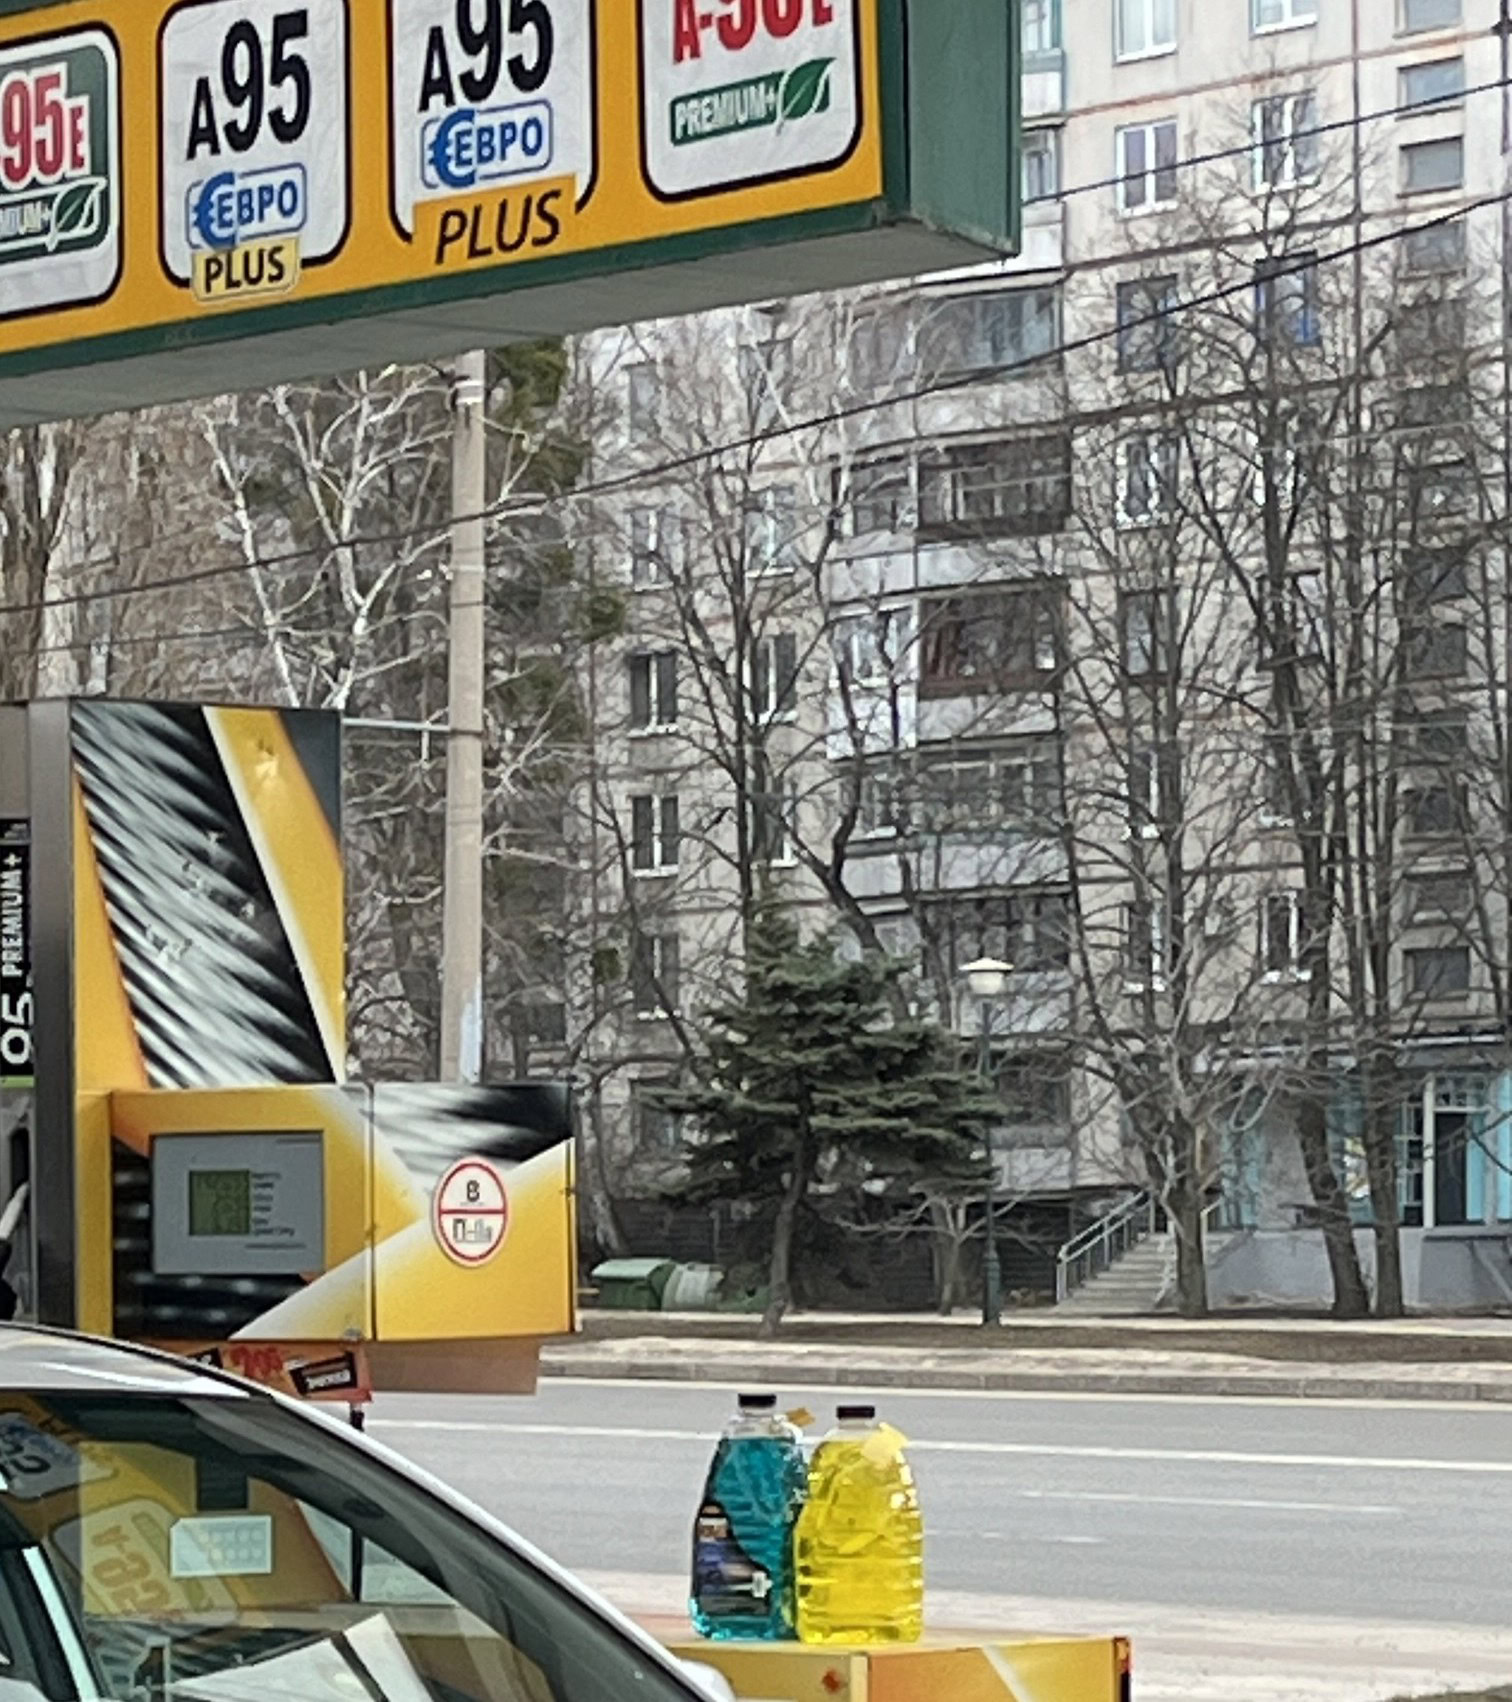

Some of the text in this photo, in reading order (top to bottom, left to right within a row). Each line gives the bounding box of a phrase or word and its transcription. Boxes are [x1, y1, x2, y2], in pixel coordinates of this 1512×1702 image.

[434, 188, 562, 265] PLUS
[205, 245, 285, 293] PLUS
[0, 853, 23, 977] PREMIUM+
